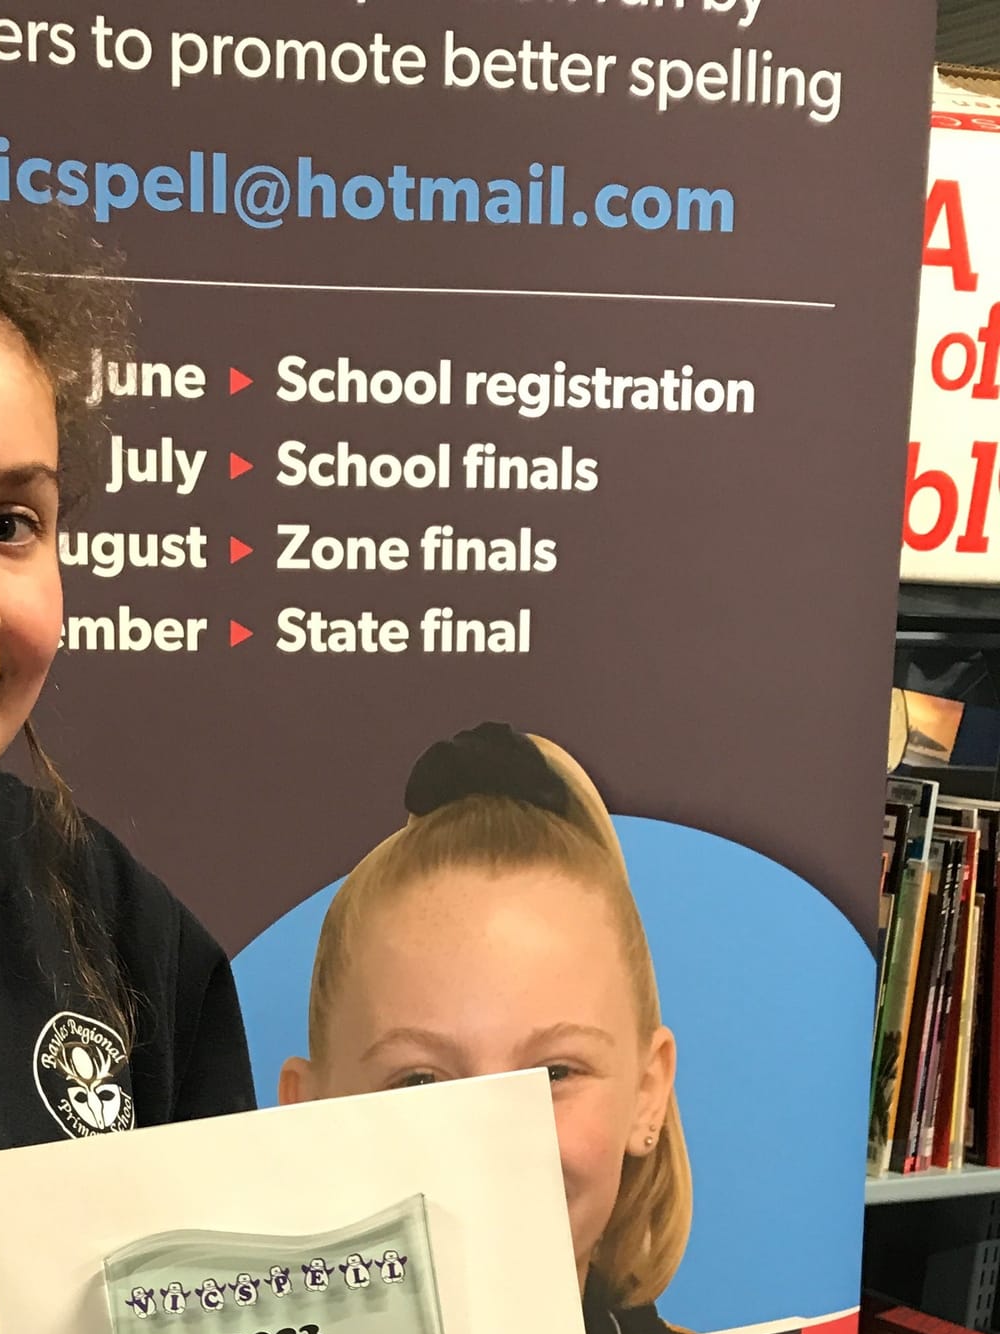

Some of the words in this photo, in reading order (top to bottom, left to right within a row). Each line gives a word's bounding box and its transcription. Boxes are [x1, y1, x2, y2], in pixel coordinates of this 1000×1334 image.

[91, 15, 153, 71] to
[170, 31, 427, 88] promote
[443, 30, 617, 95] better
[629, 47, 842, 123] spelling
[85, 348, 206, 407] June
[276, 356, 452, 405] School
[465, 361, 756, 419] registration
[105, 435, 207, 495] July
[276, 440, 451, 489] School
[463, 443, 599, 492] finals
[901, 440, 1000, 552] bl
[58, 526, 208, 578] ugust
[276, 524, 409, 572] Zone
[421, 525, 557, 573] finals
[58, 605, 208, 652] mber
[276, 607, 409, 654] State
[421, 608, 531, 654] final
[66, 1018, 126, 1064] Regional
[134, 1260, 404, 1316] VICSPELL
